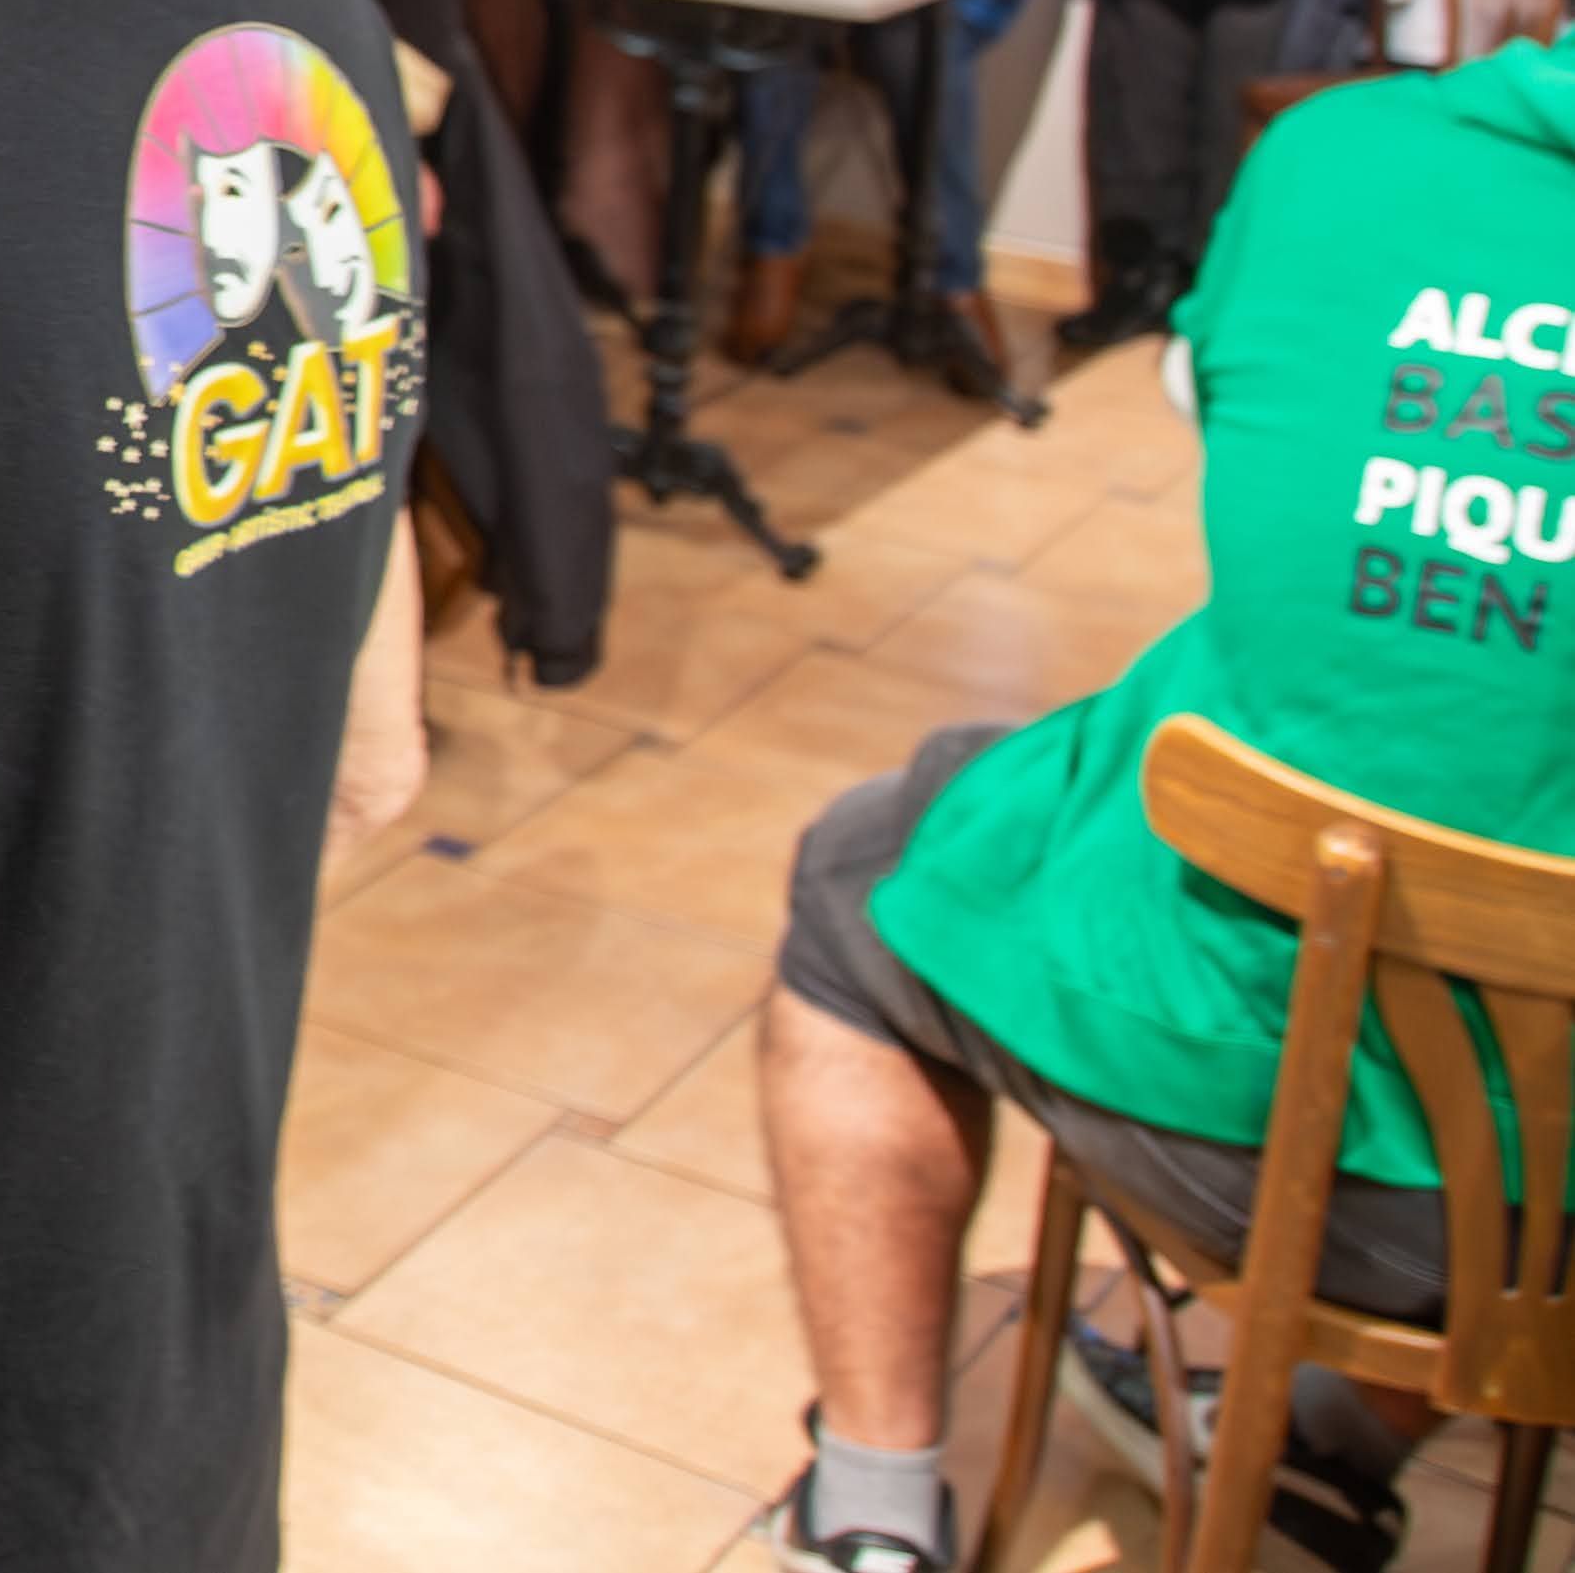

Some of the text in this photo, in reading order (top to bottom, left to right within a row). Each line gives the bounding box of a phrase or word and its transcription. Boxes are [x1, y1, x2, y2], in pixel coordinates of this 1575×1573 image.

[173, 316, 400, 525] GAT
[1384, 364, 1575, 460] BAS
[1355, 456, 1575, 564] PIQU
[1351, 547, 1548, 652] BEN
